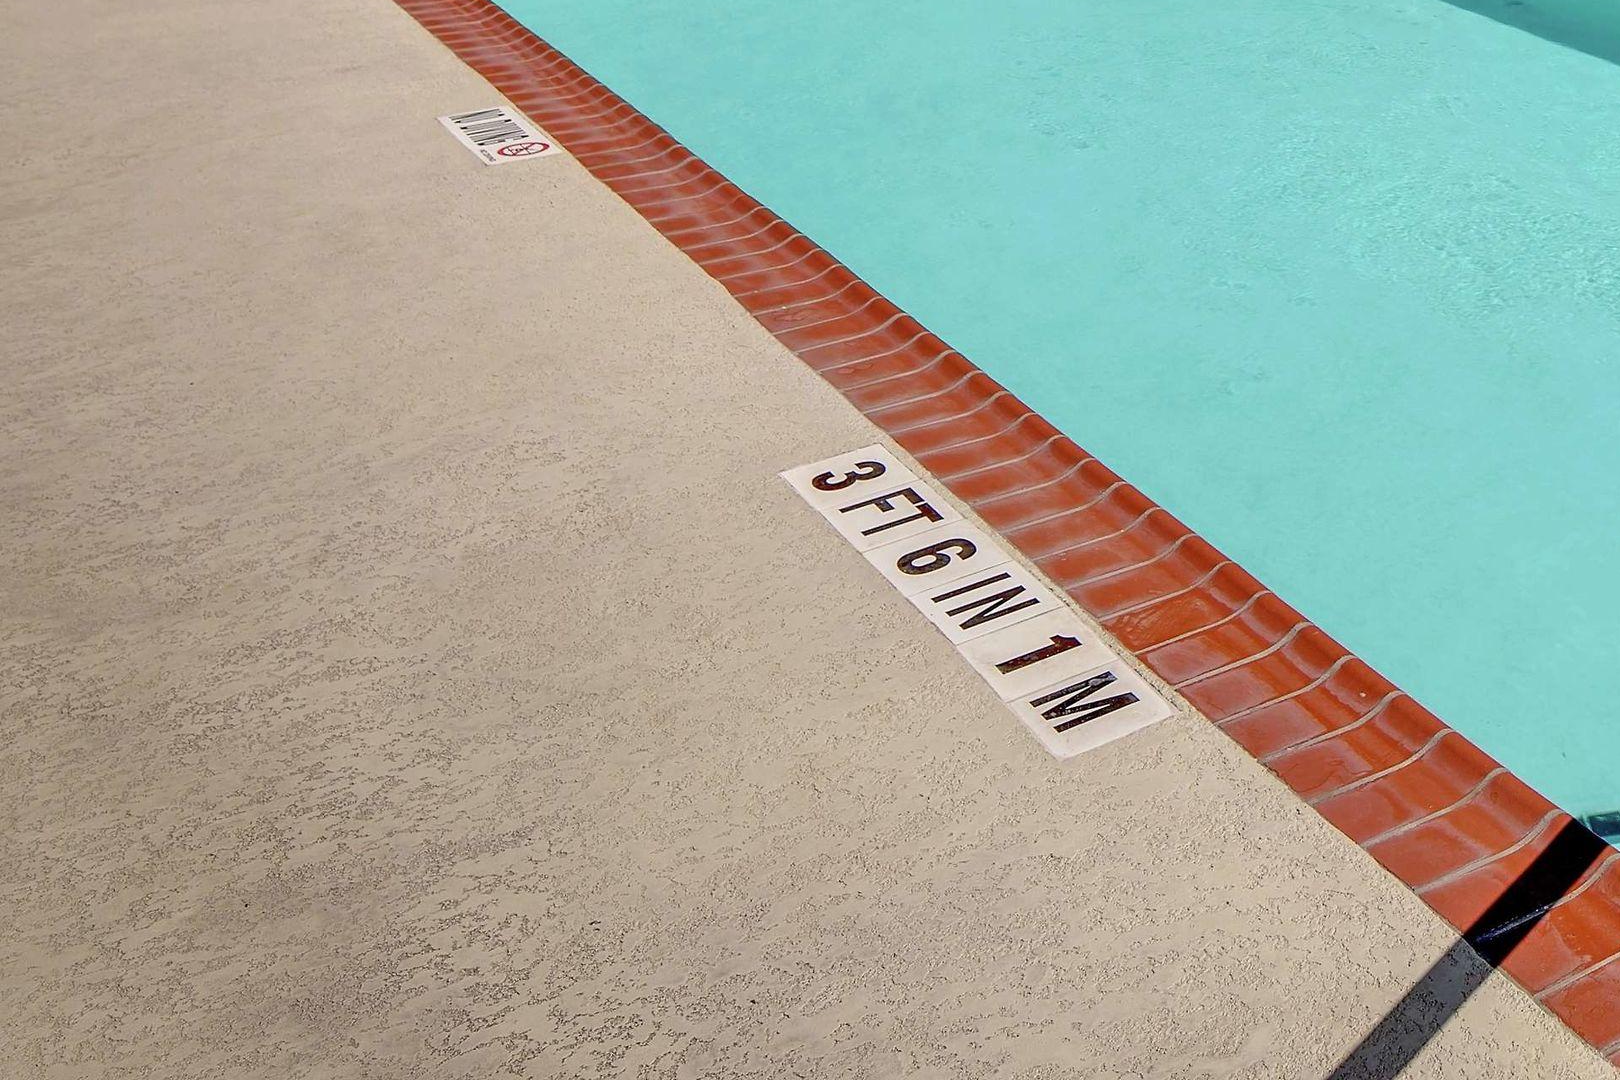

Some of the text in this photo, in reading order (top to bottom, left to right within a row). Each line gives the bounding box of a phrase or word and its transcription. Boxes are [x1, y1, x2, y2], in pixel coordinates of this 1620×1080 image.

[448, 108, 530, 146] NO DIVING
[811, 460, 1141, 734] 3 FT 6 IN 1 M
